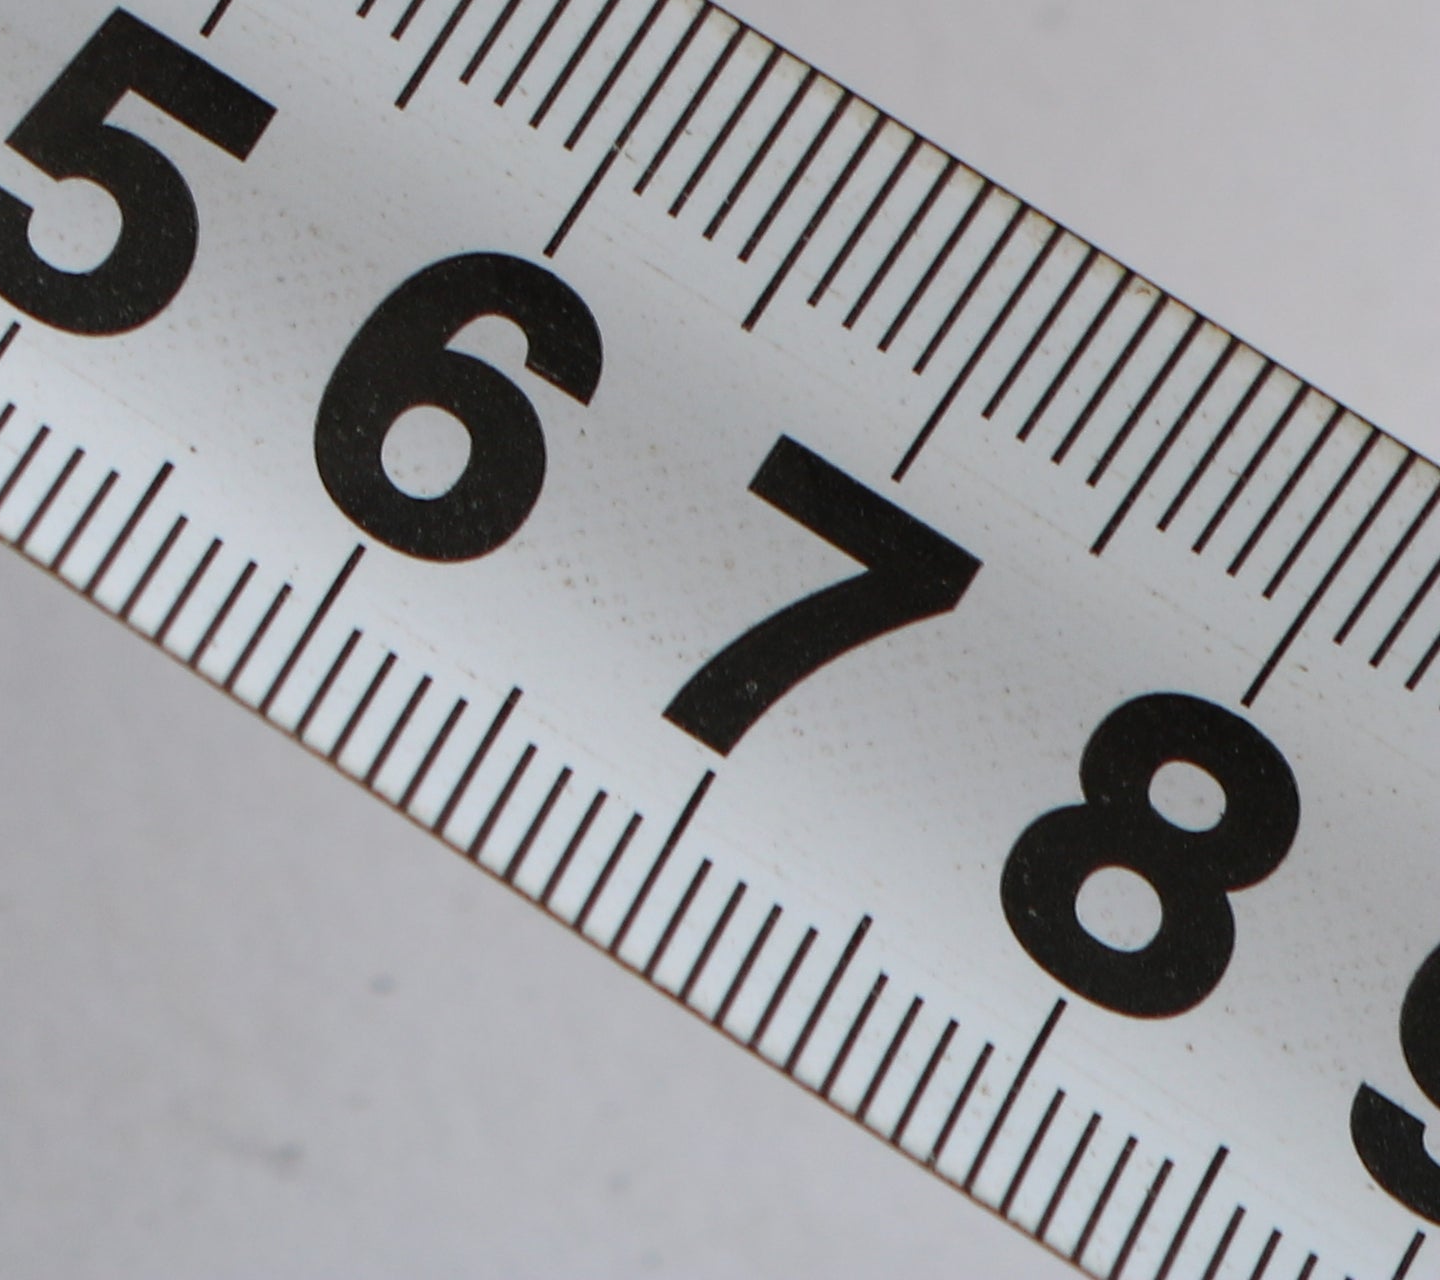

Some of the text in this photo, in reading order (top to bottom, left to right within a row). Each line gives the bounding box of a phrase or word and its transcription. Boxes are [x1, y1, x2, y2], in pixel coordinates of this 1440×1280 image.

[312, 250, 605, 564] 6
[661, 433, 984, 758] 7
[998, 691, 1302, 1020] 8
